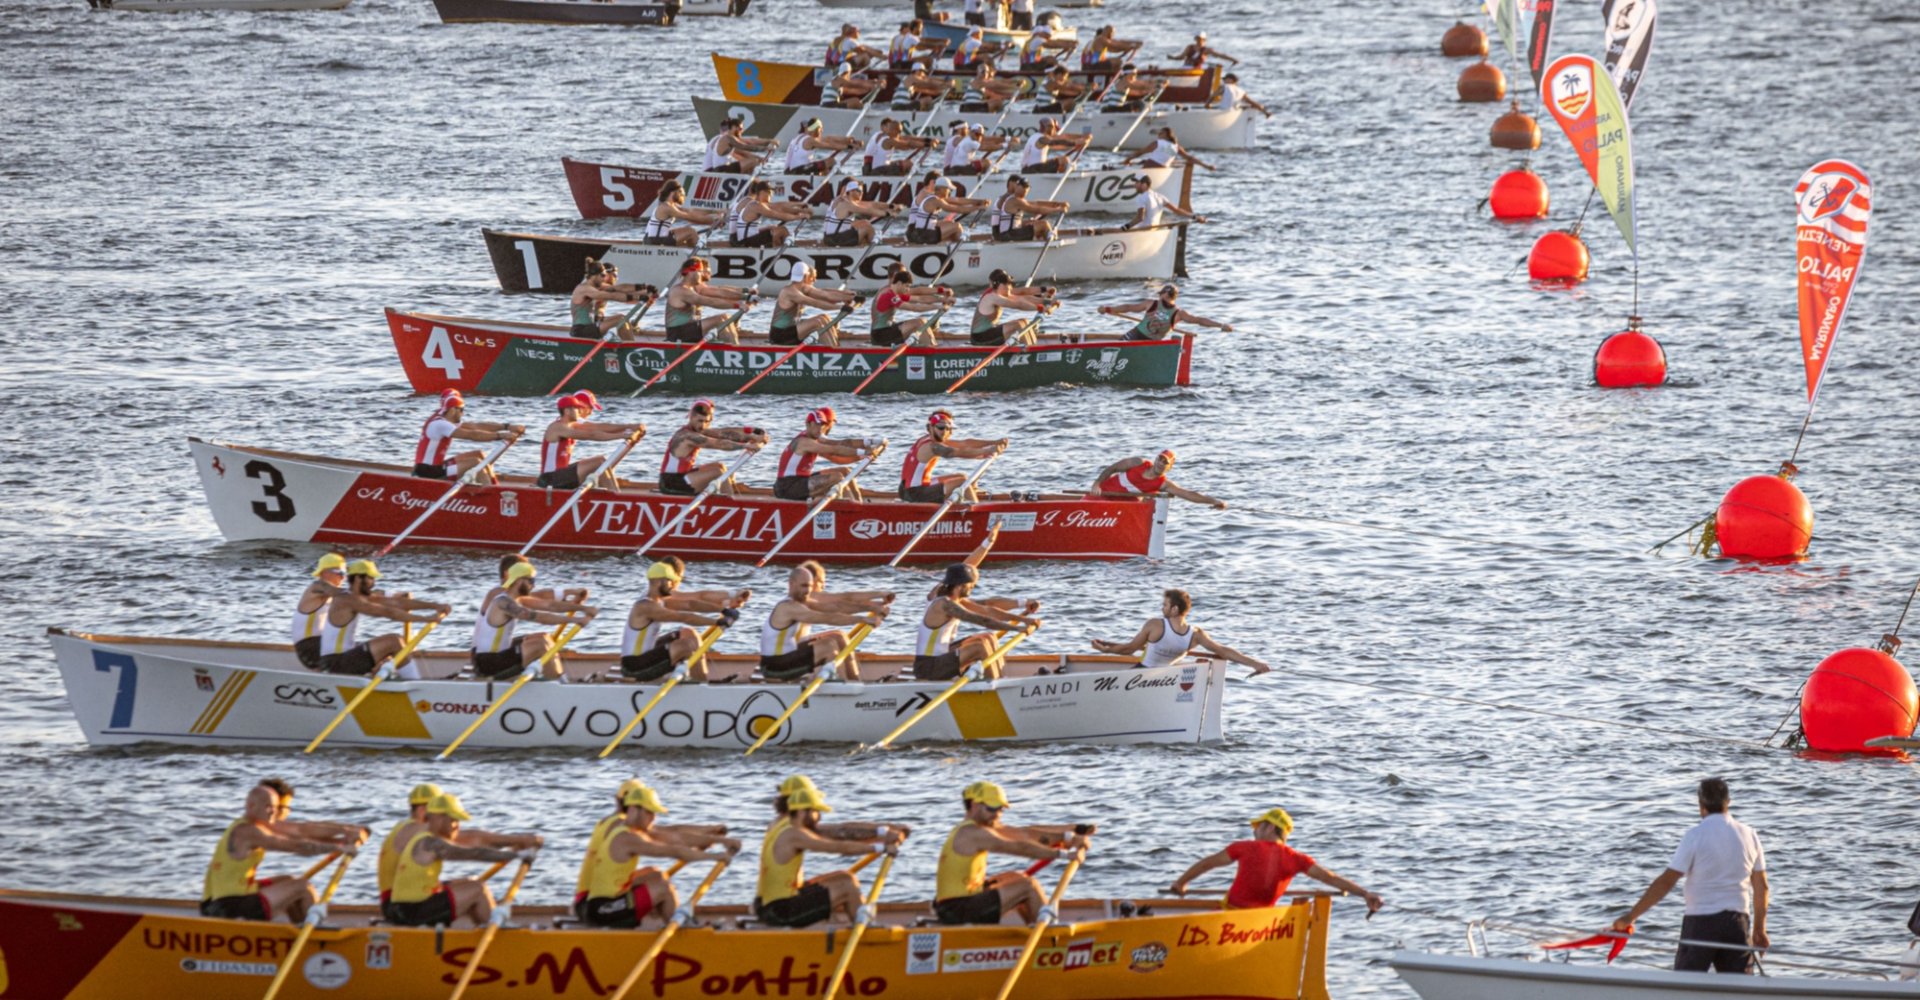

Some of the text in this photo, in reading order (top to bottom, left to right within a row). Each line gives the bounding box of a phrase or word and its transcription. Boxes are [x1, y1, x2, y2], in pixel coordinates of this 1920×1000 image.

[736, 61, 763, 96] 8
[599, 166, 635, 211] 5
[690, 199, 724, 209] IMPIANTI
[514, 240, 544, 289] 1
[712, 251, 955, 281] BORGO
[421, 325, 465, 380] 4
[515, 347, 556, 361] INEOS
[695, 349, 872, 371] ARDENZA
[695, 367, 745, 376] MONTENERO
[812, 369, 873, 378] QUERCIANELLA
[243, 459, 297, 523] 3
[356, 487, 385, 502] A.
[567, 500, 786, 542] VENEZIA
[92, 649, 138, 728] 7
[274, 684, 335, 704] CMG
[1020, 681, 1080, 698] LANDI
[1094, 674, 1179, 692] M. Camici
[144, 928, 297, 960] UNIPORT
[1217, 917, 1296, 946] Barontini
[1037, 941, 1119, 970] comet
[650, 950, 888, 998] Pontino
